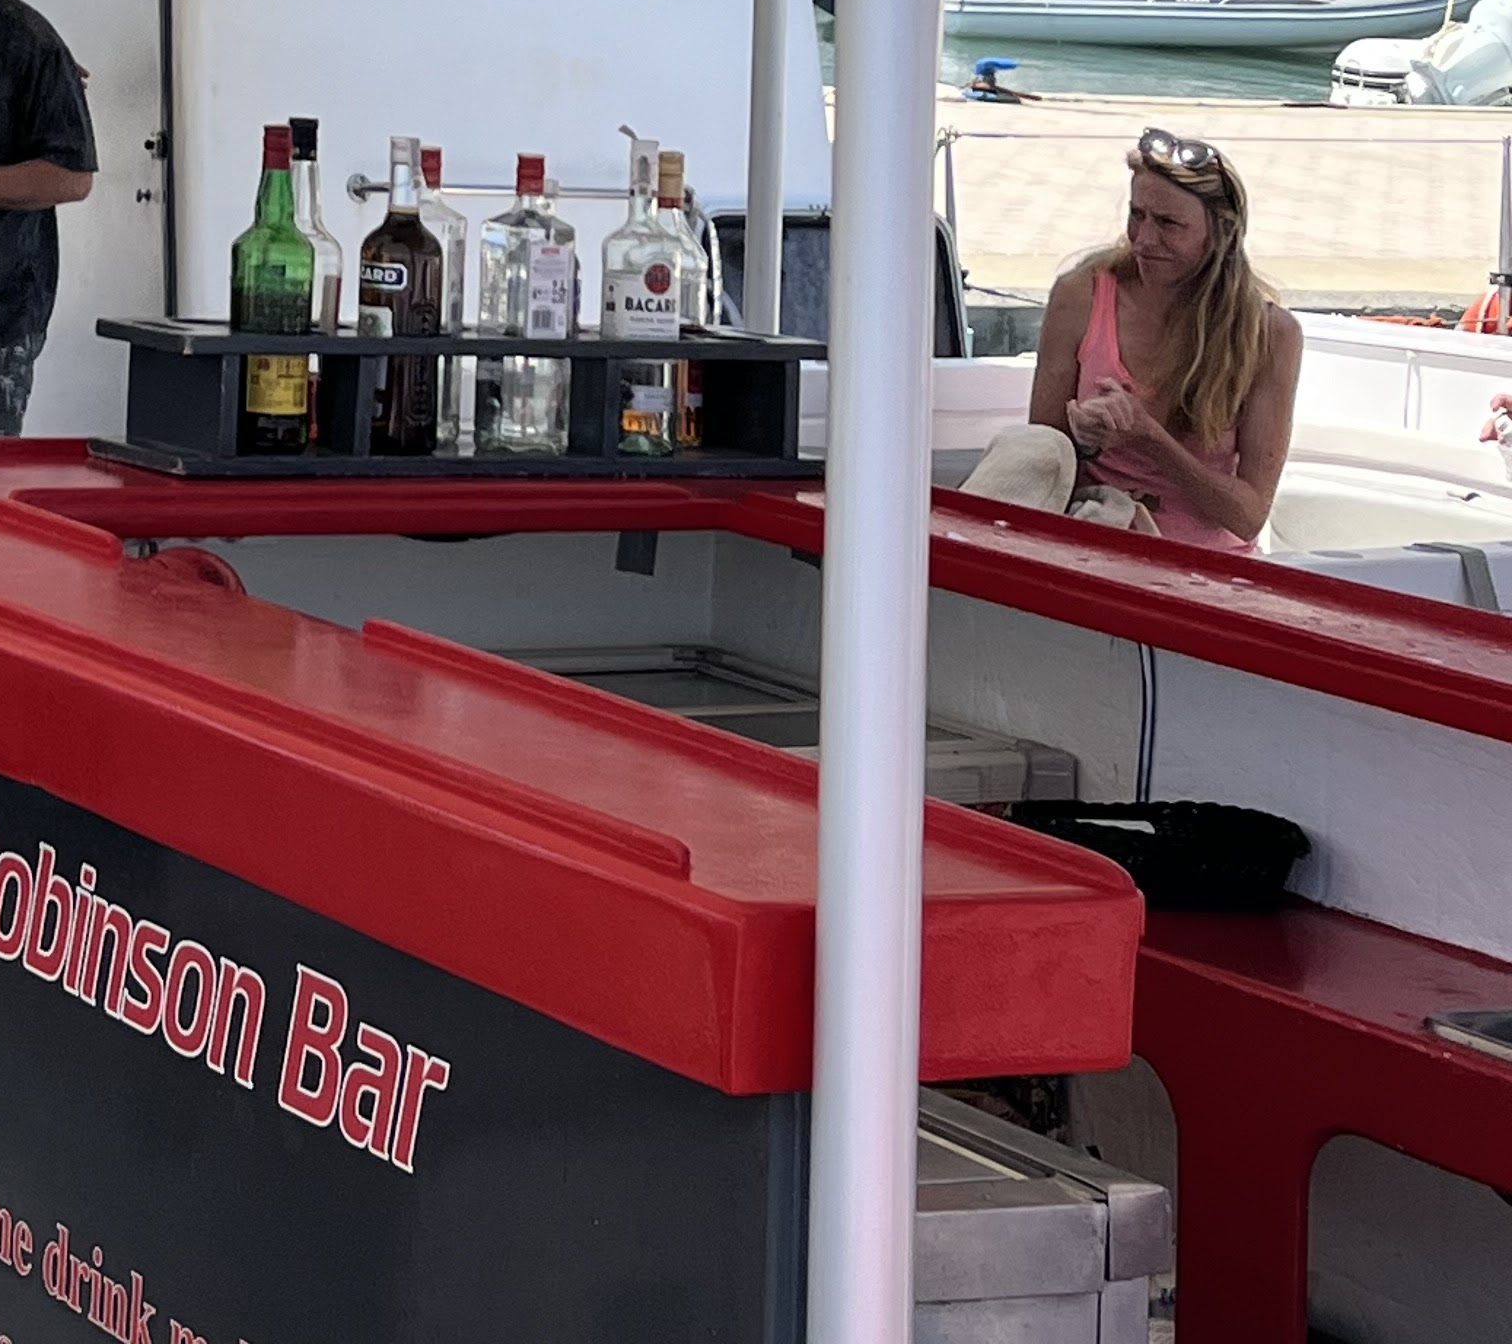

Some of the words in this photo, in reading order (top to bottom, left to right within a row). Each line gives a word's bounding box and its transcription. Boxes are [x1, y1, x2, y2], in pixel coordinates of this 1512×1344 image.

[361, 266, 398, 283] ARD
[278, 963, 451, 1173] Bar
[42, 1223, 157, 1344] drink
